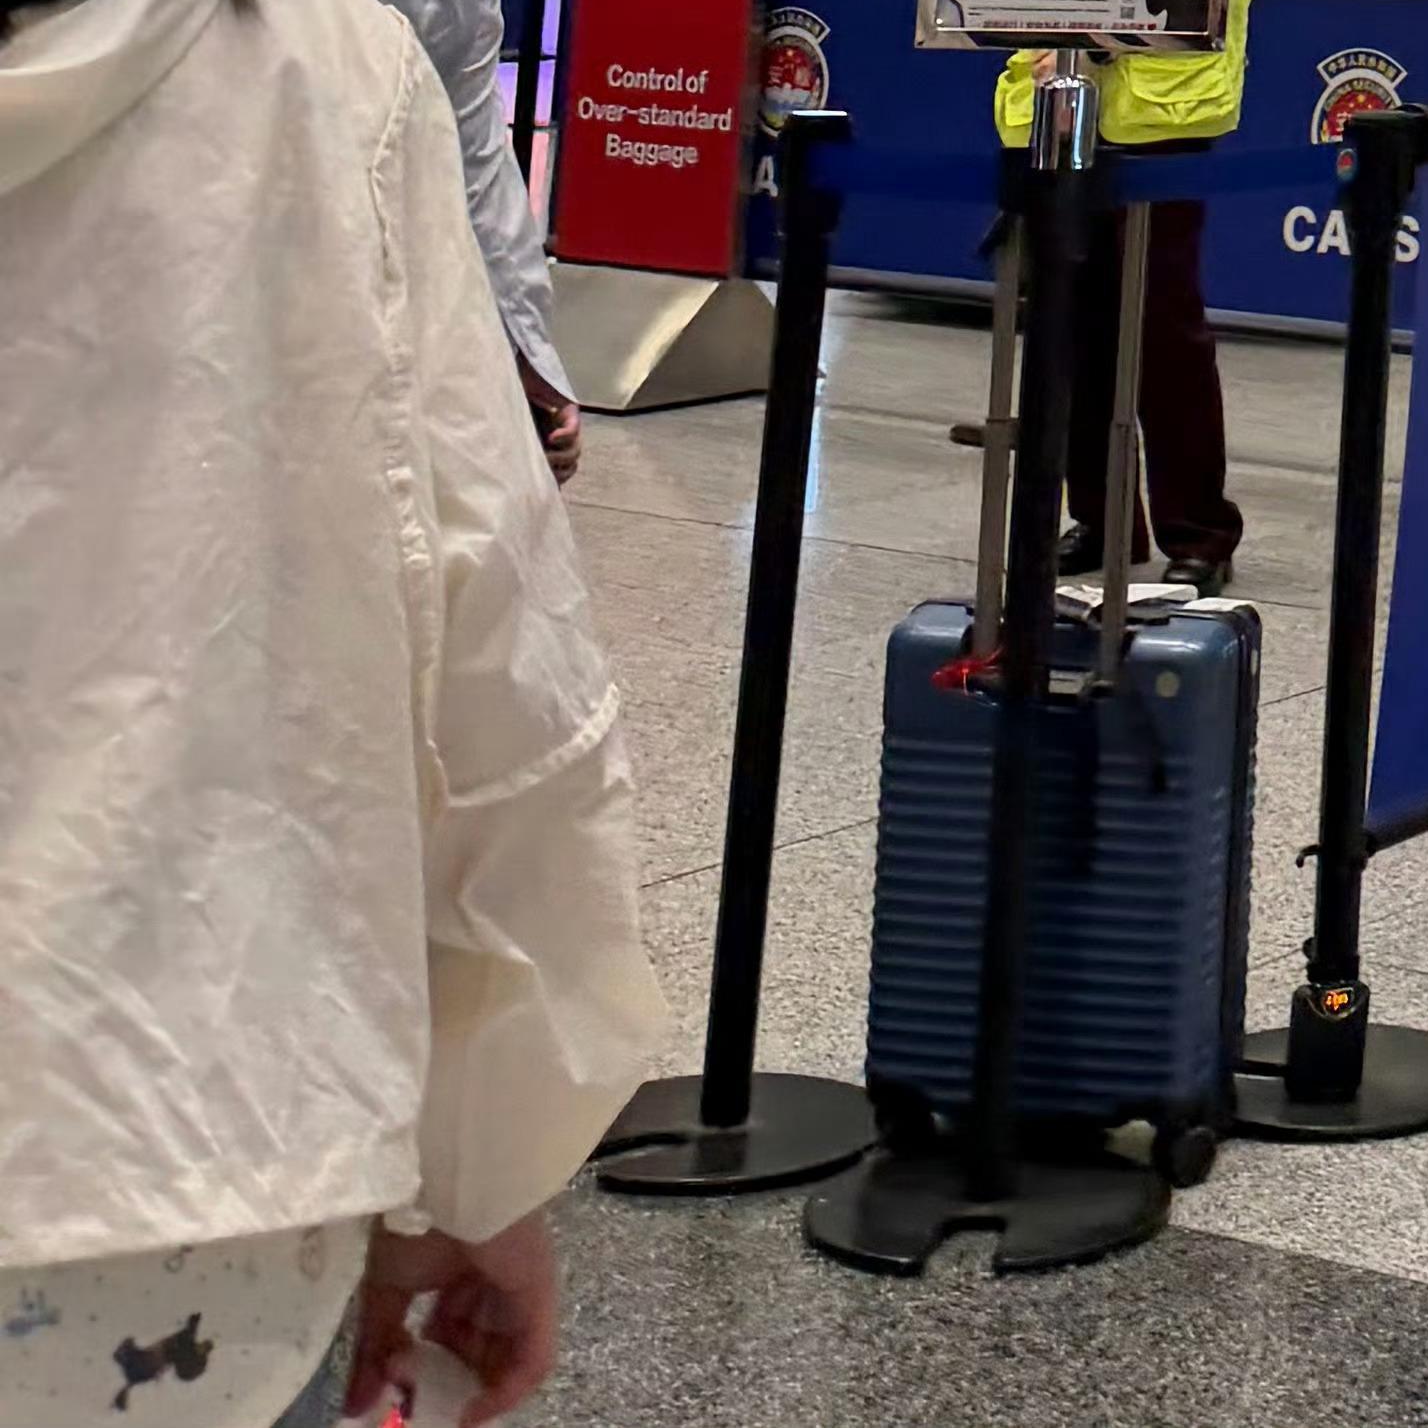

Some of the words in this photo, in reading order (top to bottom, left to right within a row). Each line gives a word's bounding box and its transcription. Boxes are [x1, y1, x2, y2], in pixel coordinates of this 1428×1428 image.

[606, 63, 683, 92] Control
[685, 70, 710, 95] of
[577, 96, 732, 132] Over-standard
[605, 133, 699, 169] Baggage
[1282, 205, 1421, 263] CAS
